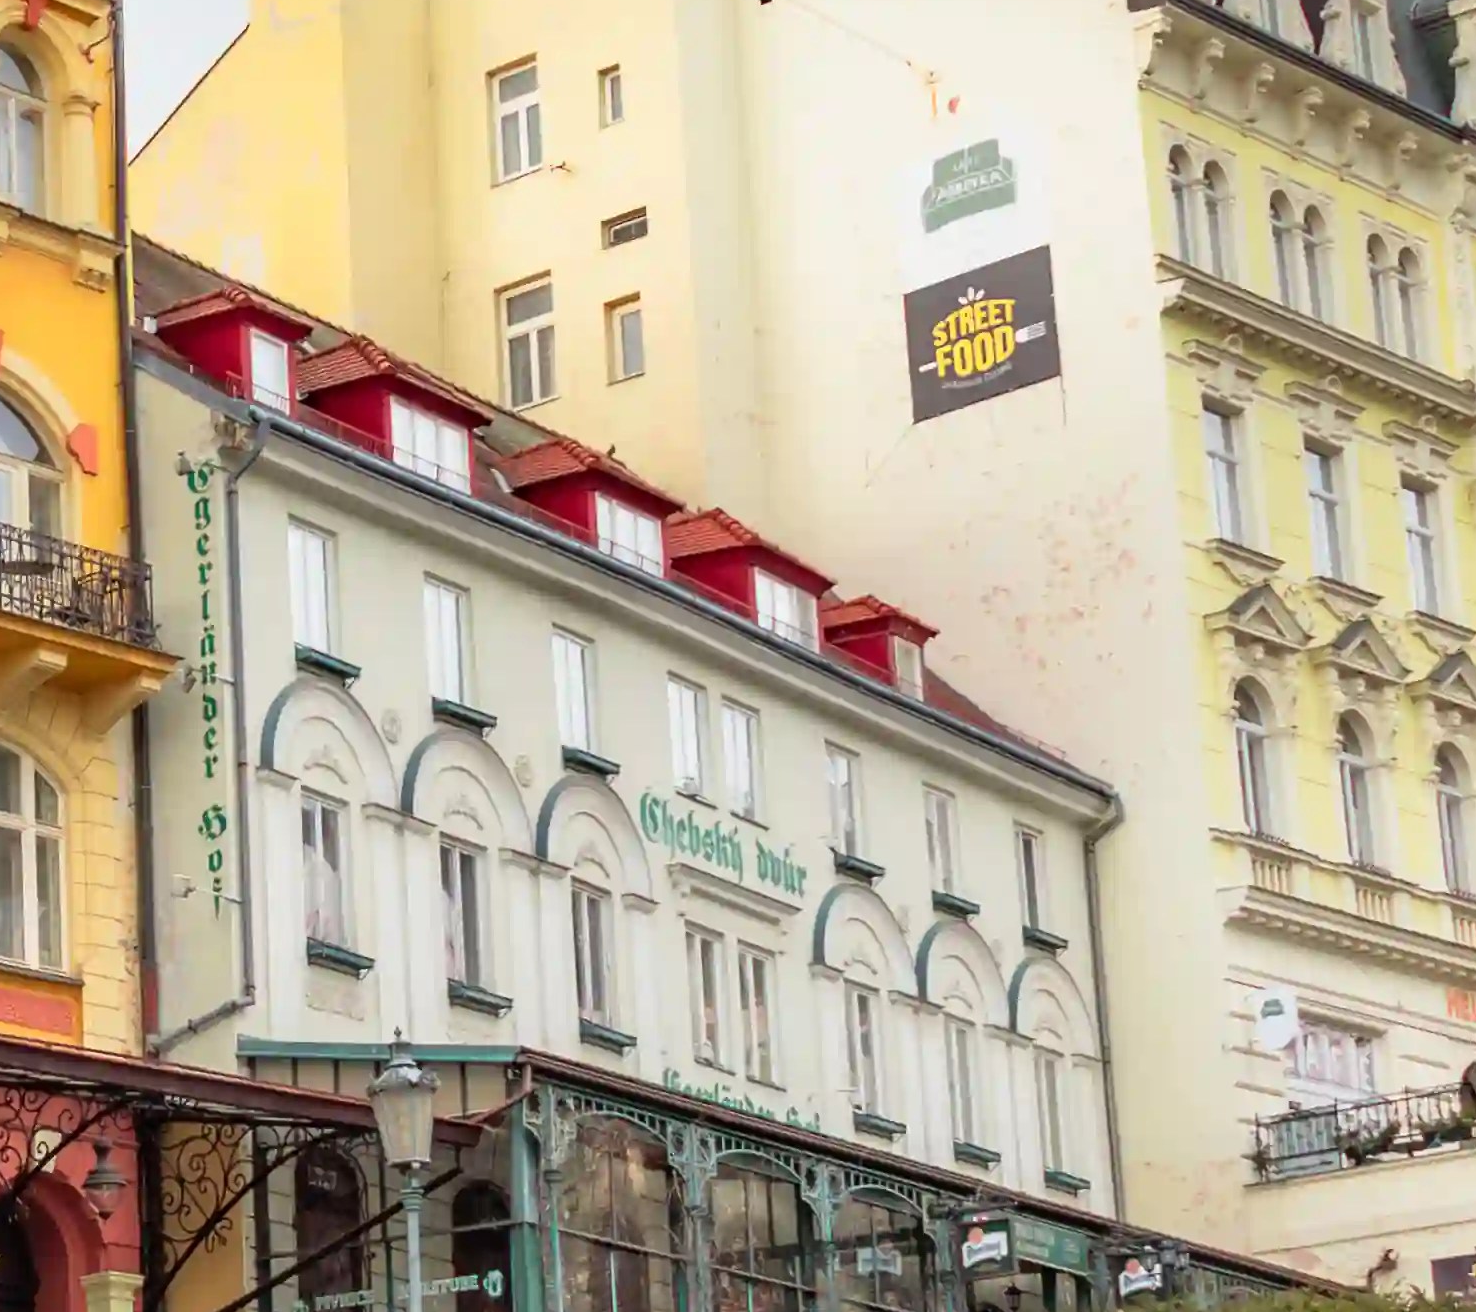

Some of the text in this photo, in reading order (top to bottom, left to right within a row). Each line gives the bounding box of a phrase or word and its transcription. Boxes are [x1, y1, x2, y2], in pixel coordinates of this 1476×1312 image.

[932, 299, 1016, 347] STREET
[935, 325, 1015, 378] FOOD
[640, 791, 744, 886] Chebský
